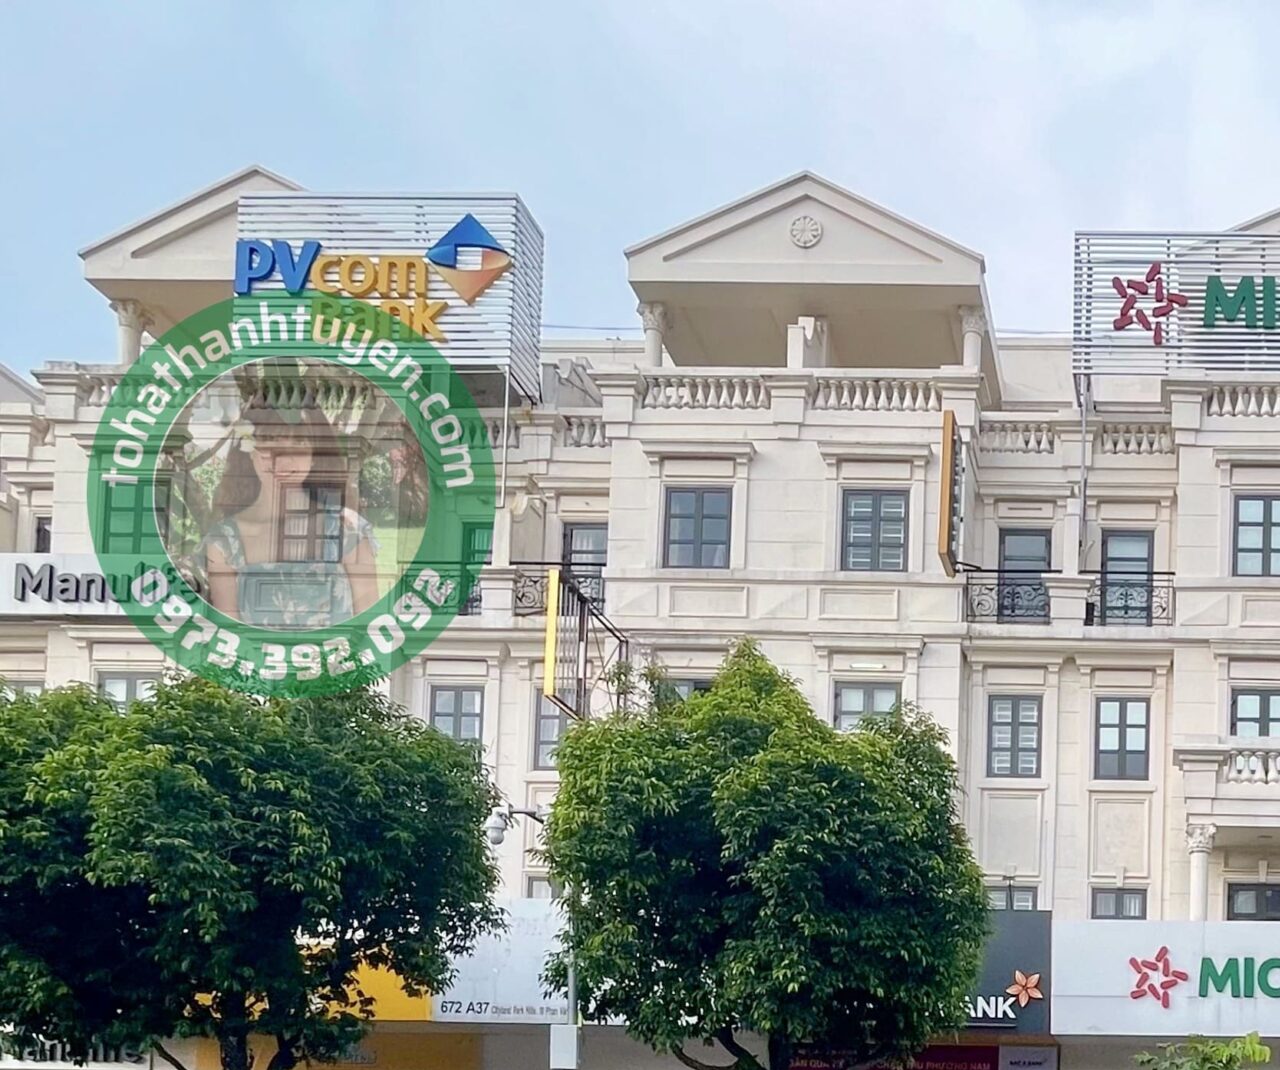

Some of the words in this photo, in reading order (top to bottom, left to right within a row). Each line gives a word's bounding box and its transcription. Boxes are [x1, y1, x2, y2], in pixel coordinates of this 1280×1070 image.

[235, 238, 429, 297] PVcom
[440, 1001, 463, 1014] 672
[466, 1001, 490, 1014] A37
